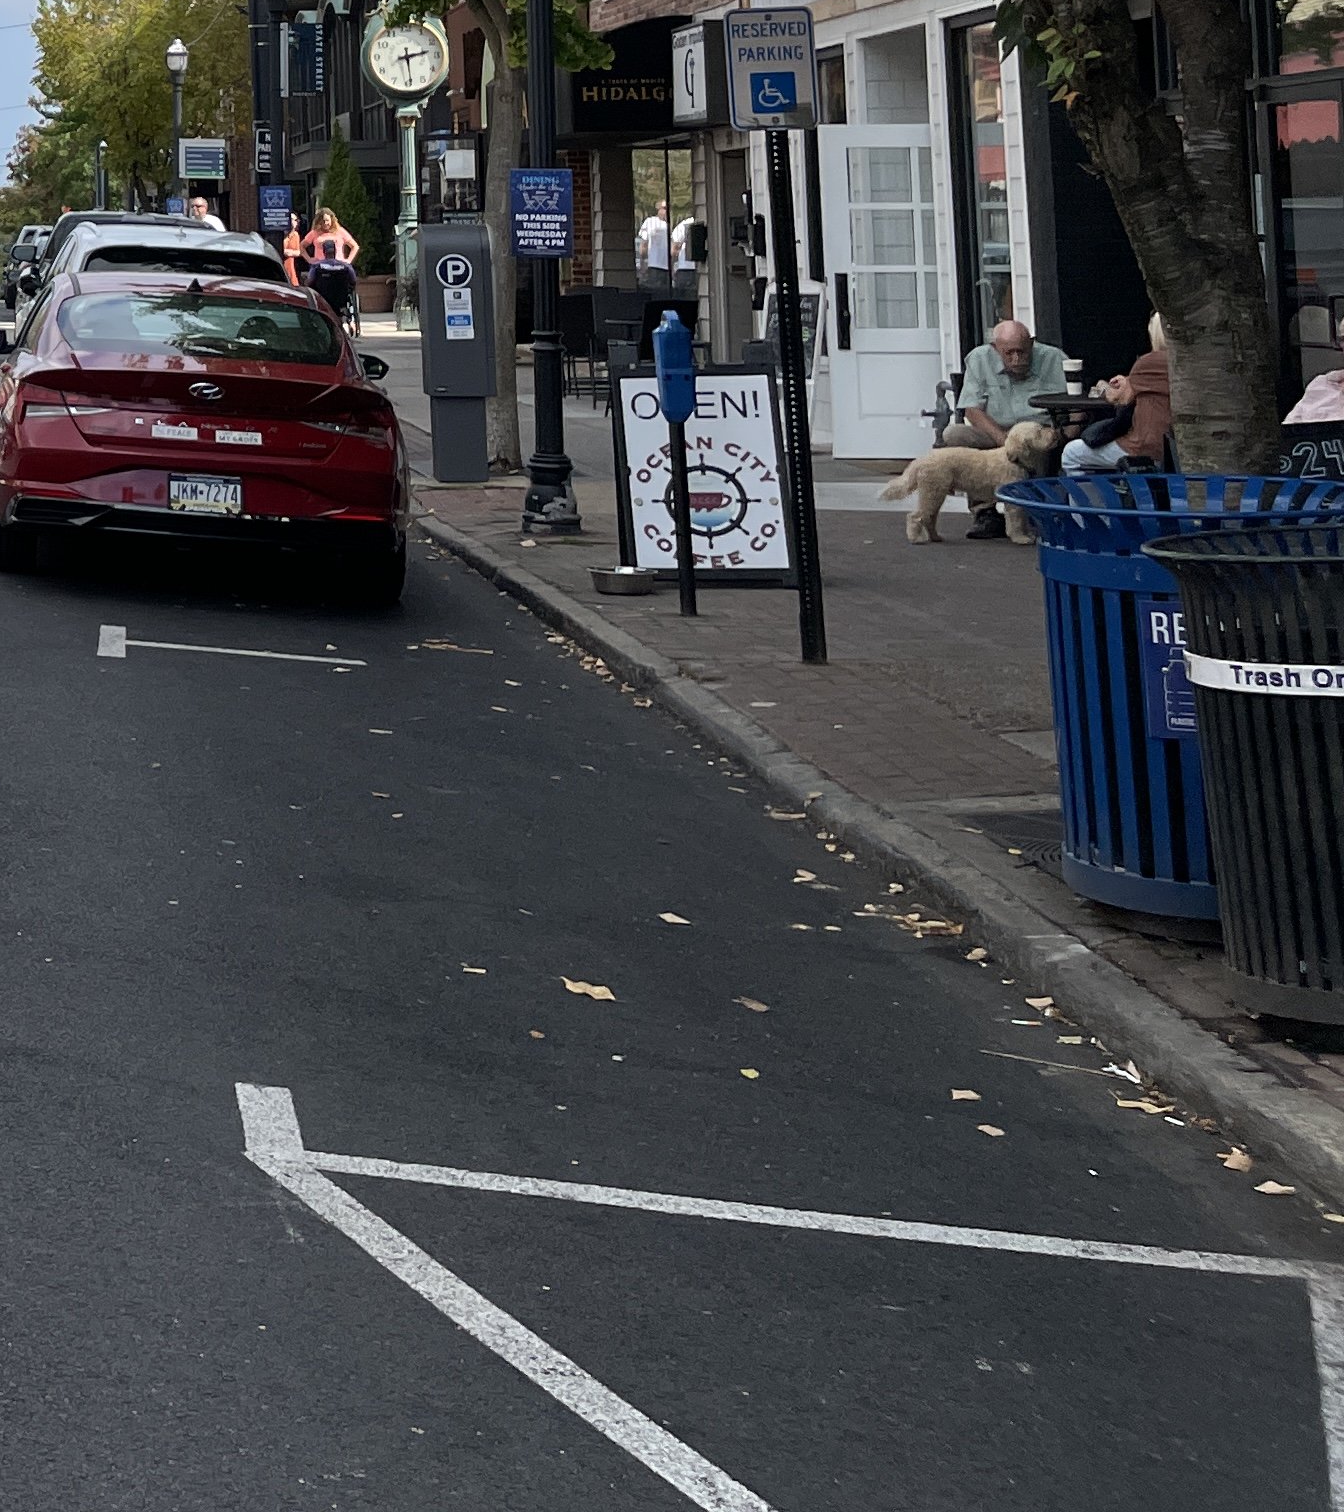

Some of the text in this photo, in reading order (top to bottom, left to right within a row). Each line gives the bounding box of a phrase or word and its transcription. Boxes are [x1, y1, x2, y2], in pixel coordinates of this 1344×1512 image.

[732, 21, 807, 39] RESERVED
[315, 24, 324, 92] STATE STREET
[738, 45, 804, 62] PARKING
[582, 85, 673, 102] HIDALG
[521, 175, 560, 184] DINING
[515, 213, 567, 222] NO PARKING
[523, 222, 561, 230] THIS SIDE
[516, 230, 567, 238] WEDNESDAY
[518, 238, 565, 247] AFTER 4 PM
[446, 260, 466, 284] P
[631, 390, 760, 420] OEN!
[723, 441, 776, 484] CITY
[643, 519, 780, 569] COFEE CO.
[1229, 664, 1301, 688] Trash
